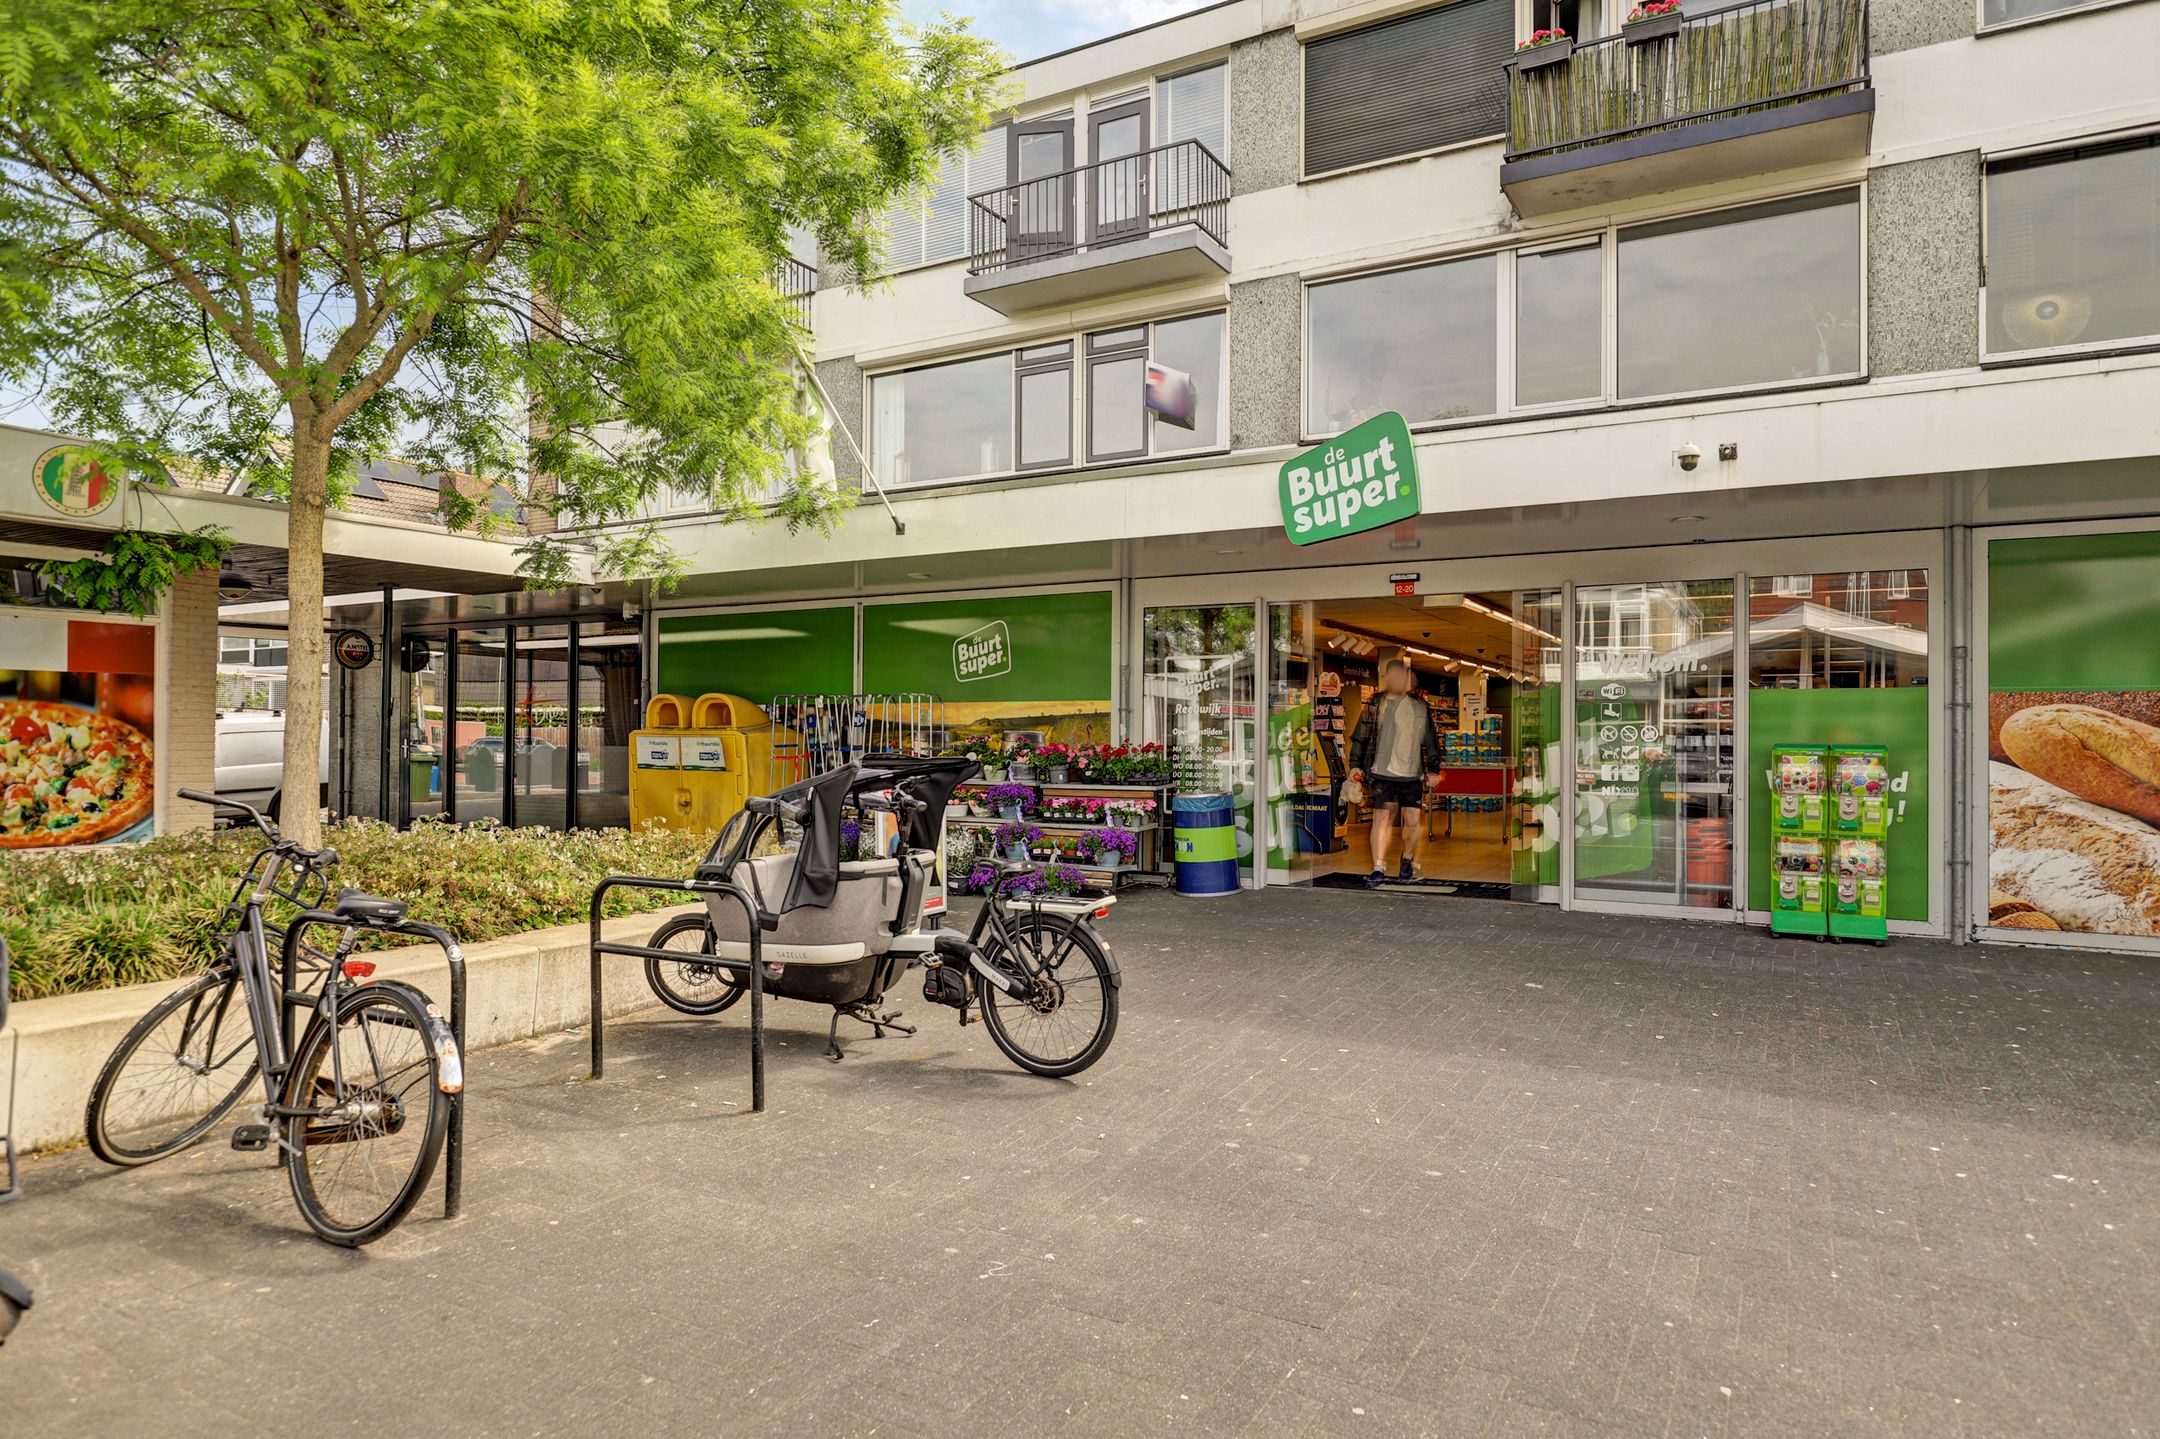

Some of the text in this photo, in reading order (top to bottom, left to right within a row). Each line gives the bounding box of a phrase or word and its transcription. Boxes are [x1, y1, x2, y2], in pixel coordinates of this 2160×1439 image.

[1324, 446, 1345, 465] de
[1287, 436, 1397, 506] Buurt
[972, 635, 983, 644] de
[957, 633, 1002, 662] Buurt
[1172, 728, 1223, 737] Openstijden
[776, 951, 808, 960] GAZELLE
